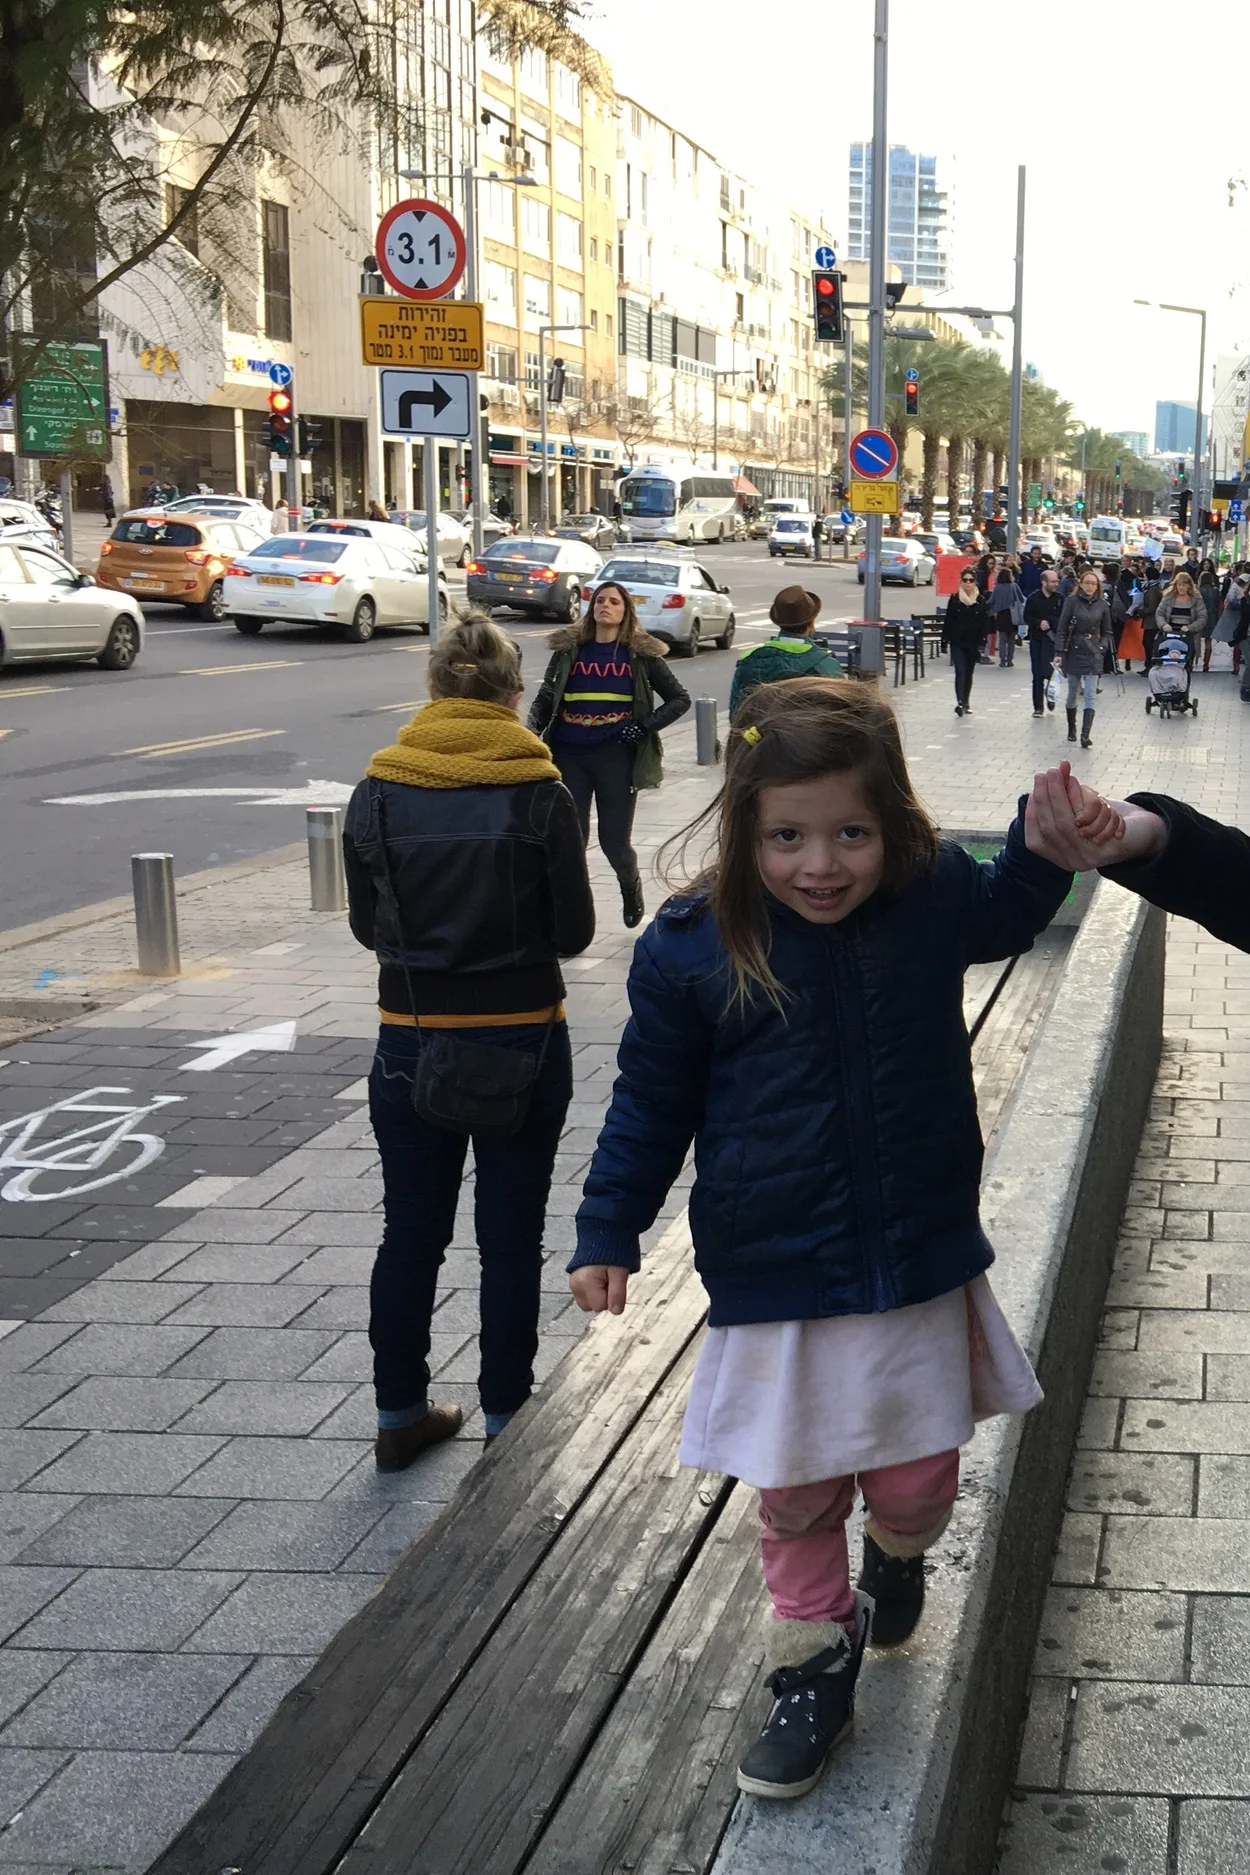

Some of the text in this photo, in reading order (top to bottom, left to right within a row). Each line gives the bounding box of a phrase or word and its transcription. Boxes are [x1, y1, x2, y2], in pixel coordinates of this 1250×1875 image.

[397, 231, 441, 266] 3.1
[398, 306, 447, 323] זהירות
[378, 323, 468, 343] בפניה ימינה
[369, 342, 479, 364] מעבר נמוך 3.1 מטר
